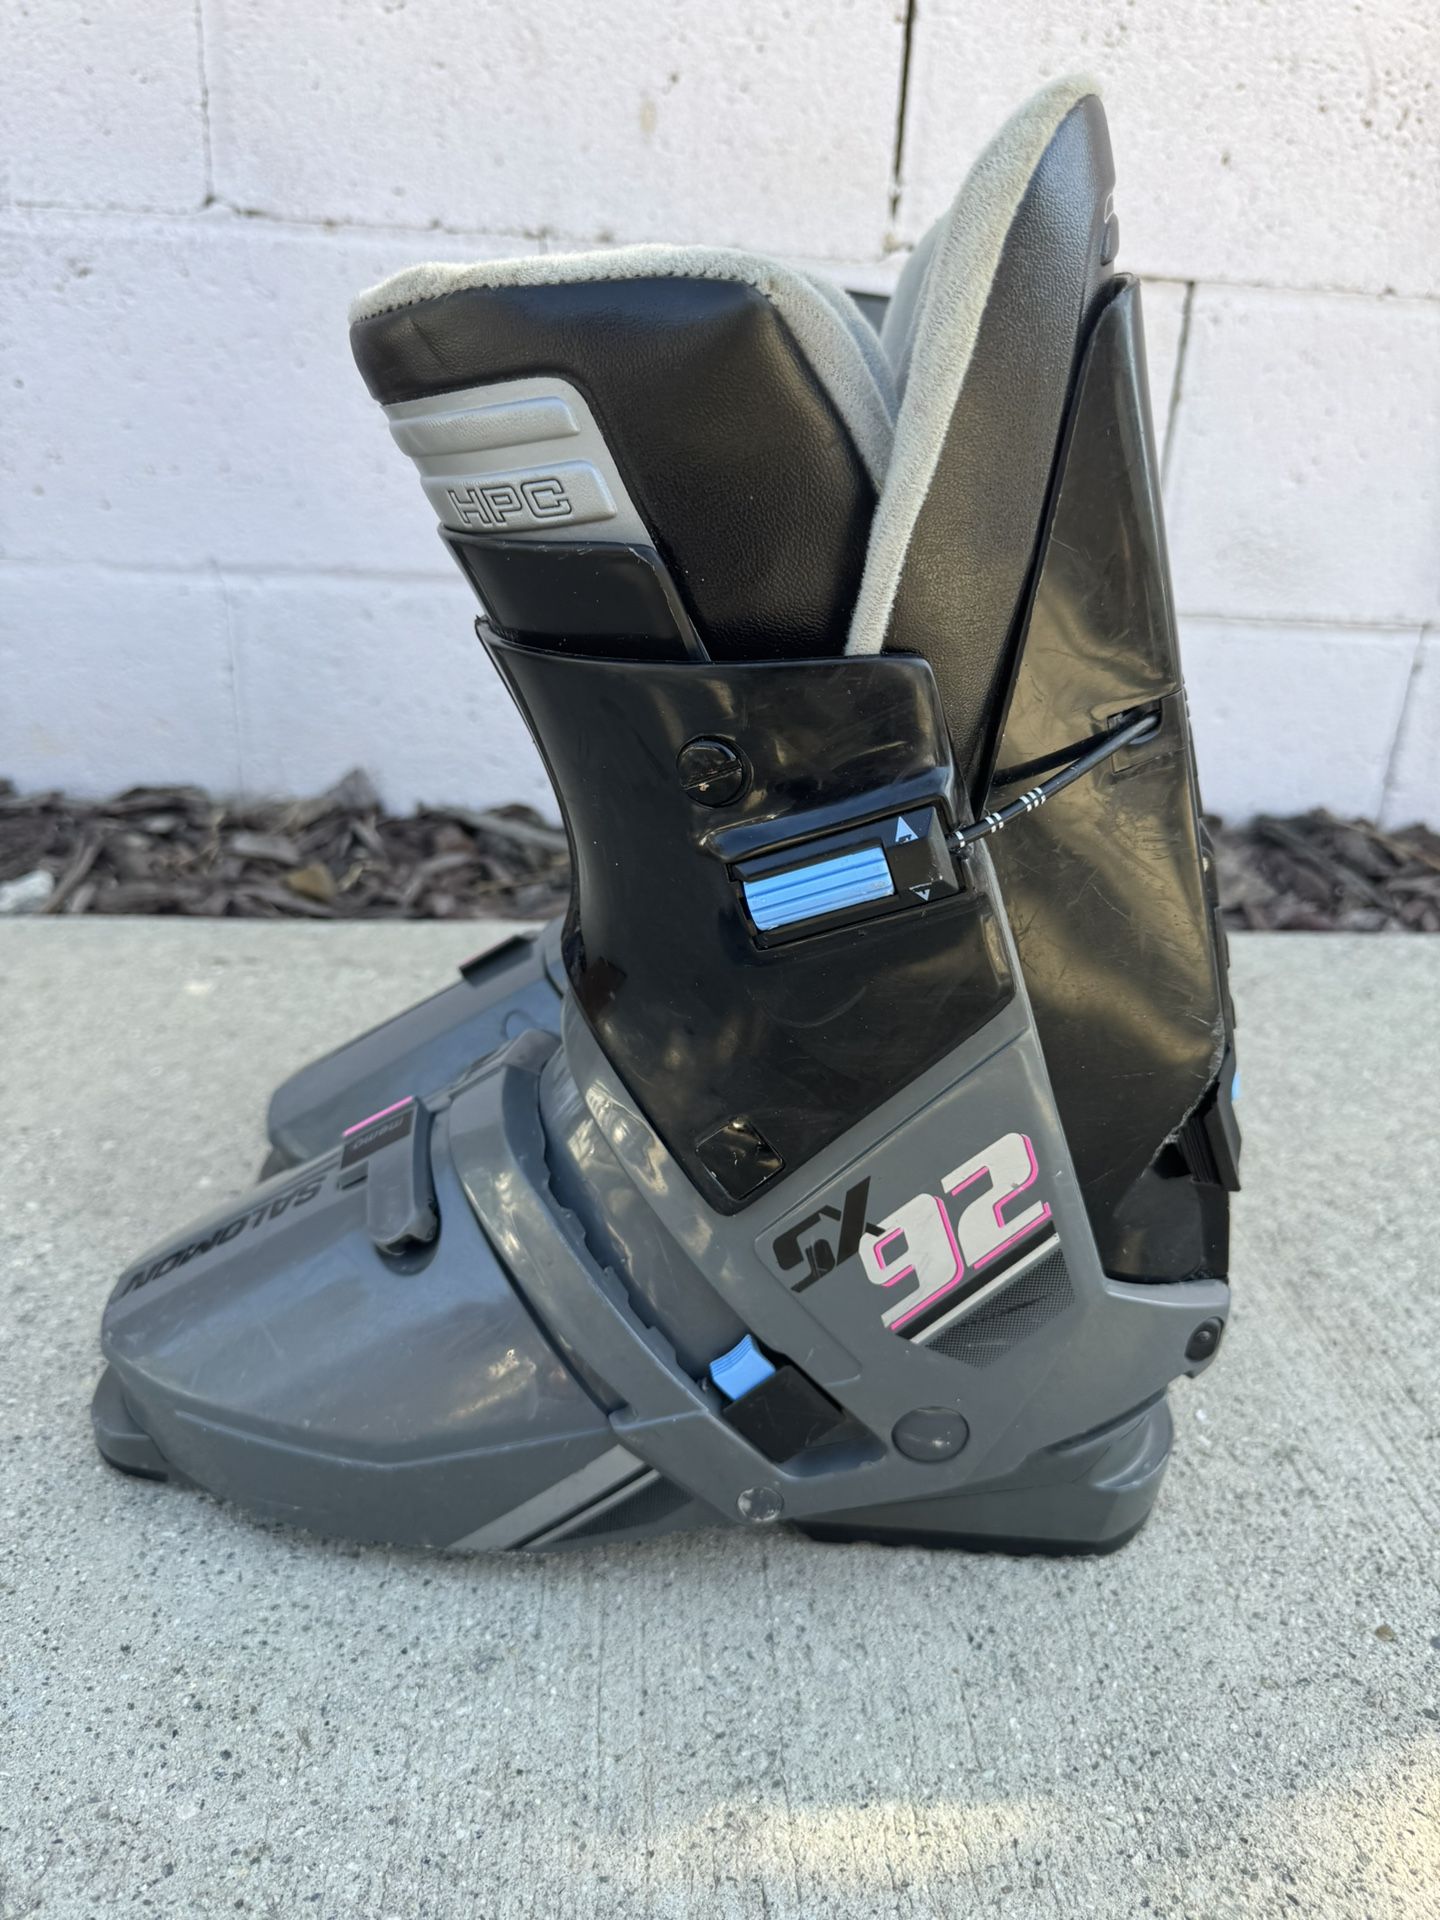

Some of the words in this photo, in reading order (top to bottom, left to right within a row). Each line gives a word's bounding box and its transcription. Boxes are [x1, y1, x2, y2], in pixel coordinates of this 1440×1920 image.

[448, 478, 573, 524] HPC
[121, 1175, 328, 1299] SALOMON
[858, 1132, 1052, 1331] 92
